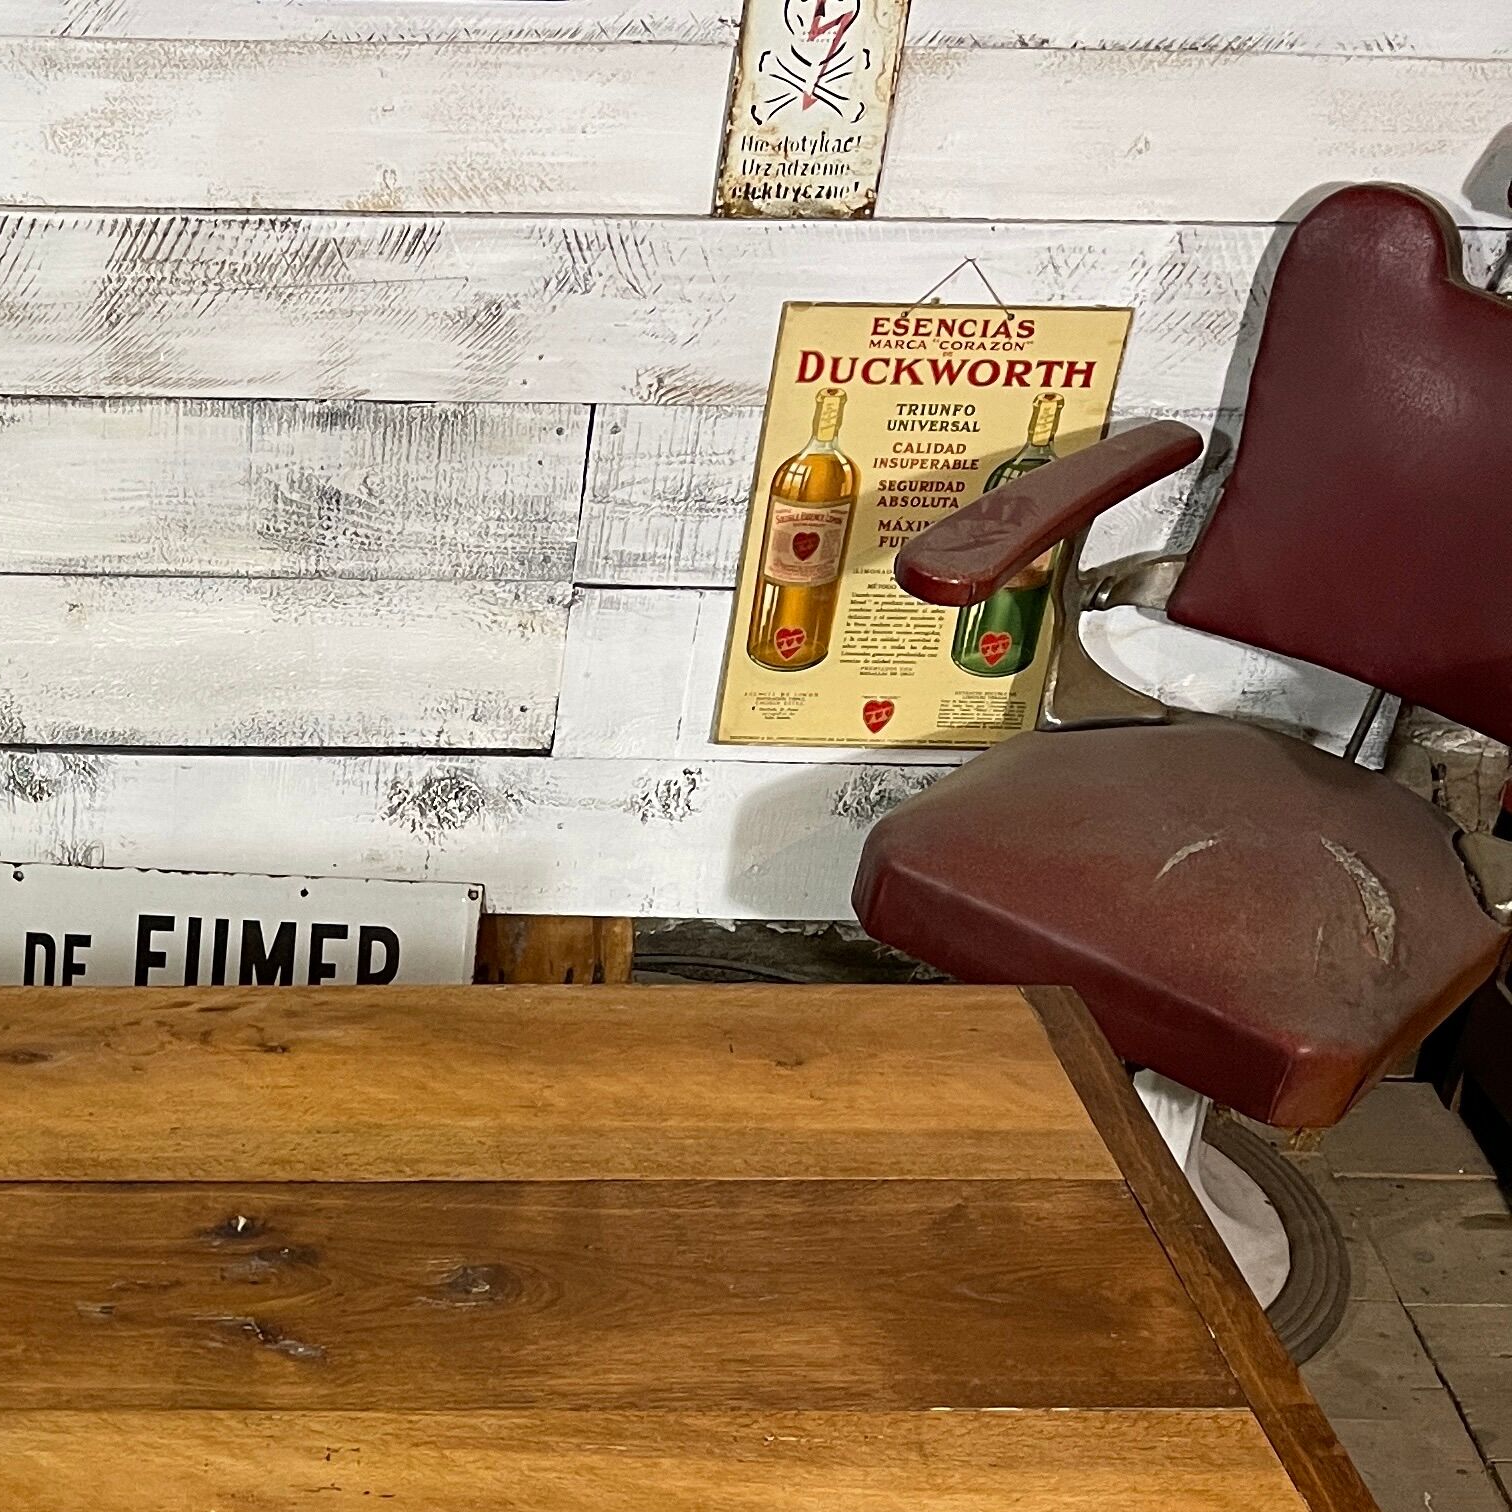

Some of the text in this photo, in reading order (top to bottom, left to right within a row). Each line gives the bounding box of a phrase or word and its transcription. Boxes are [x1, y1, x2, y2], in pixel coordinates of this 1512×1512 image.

[871, 317, 1035, 338] ESENCIAS
[869, 339, 927, 350] MARCA
[795, 350, 1098, 389] DUCKWORTH
[896, 403, 976, 417] TRIUNFO
[887, 419, 981, 433] UNIVERSAL
[892, 442, 967, 455] CALIDAD
[872, 457, 980, 471] INSUPERABLE
[877, 479, 966, 493] SEGURIDAD
[876, 495, 960, 509] ABSOLUTA
